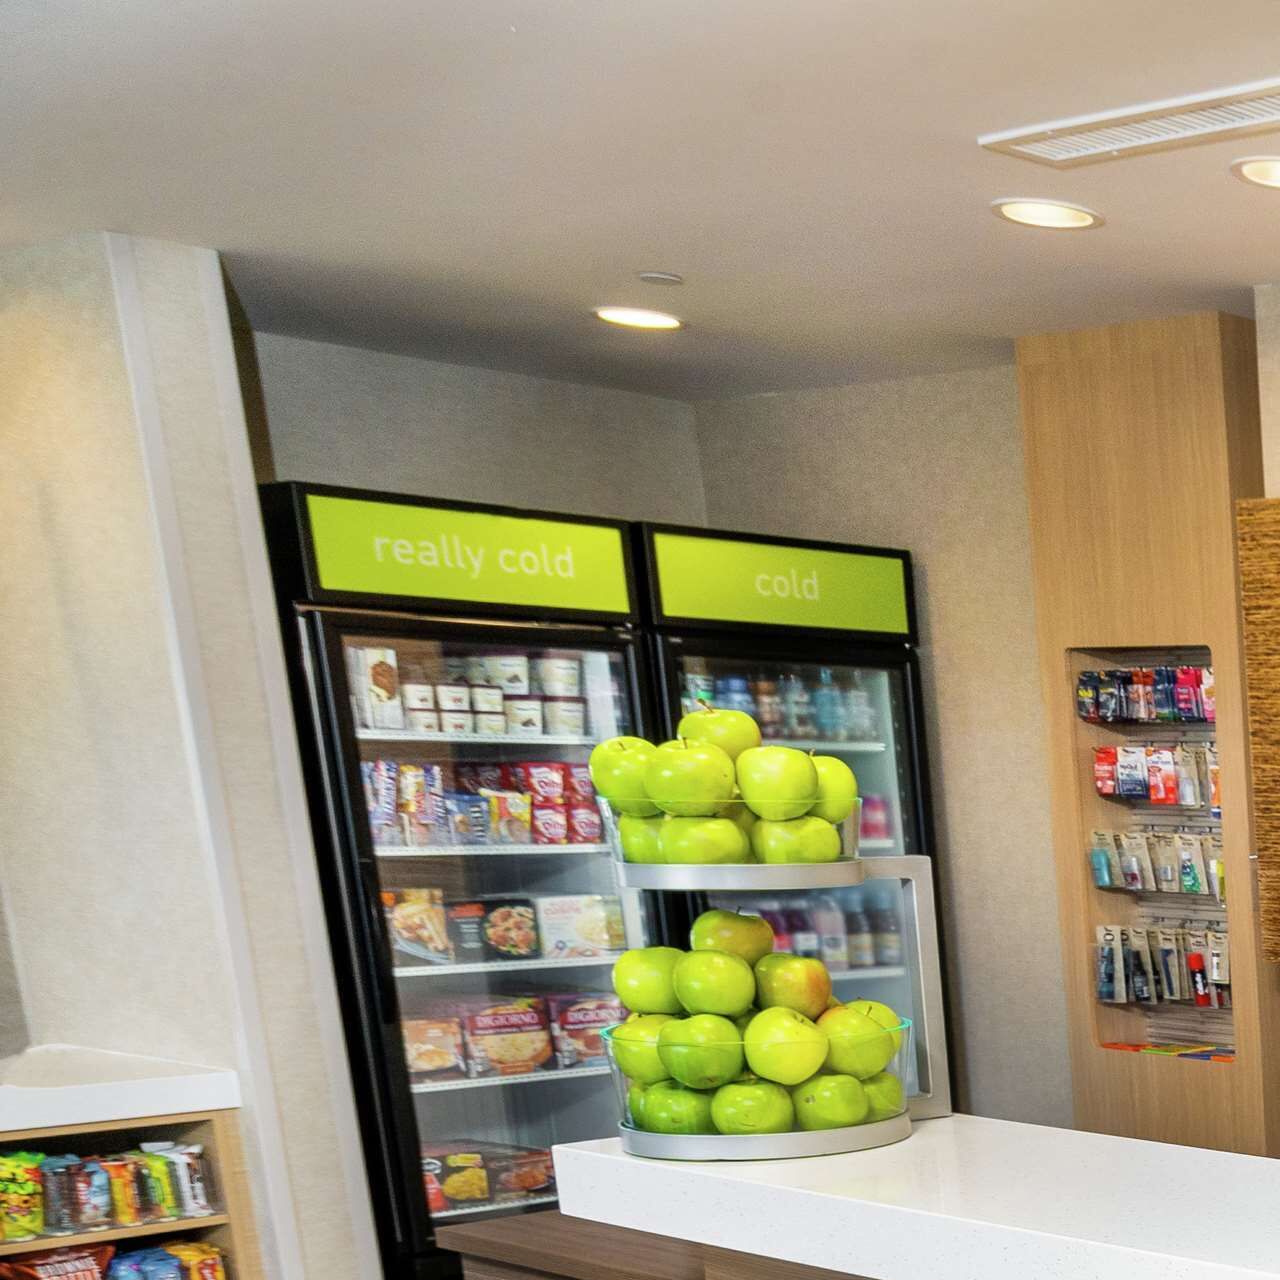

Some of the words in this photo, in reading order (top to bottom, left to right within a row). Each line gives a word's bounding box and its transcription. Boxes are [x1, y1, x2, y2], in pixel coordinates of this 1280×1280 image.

[374, 534, 485, 577] really
[500, 546, 575, 577] cold
[756, 569, 819, 600] cold
